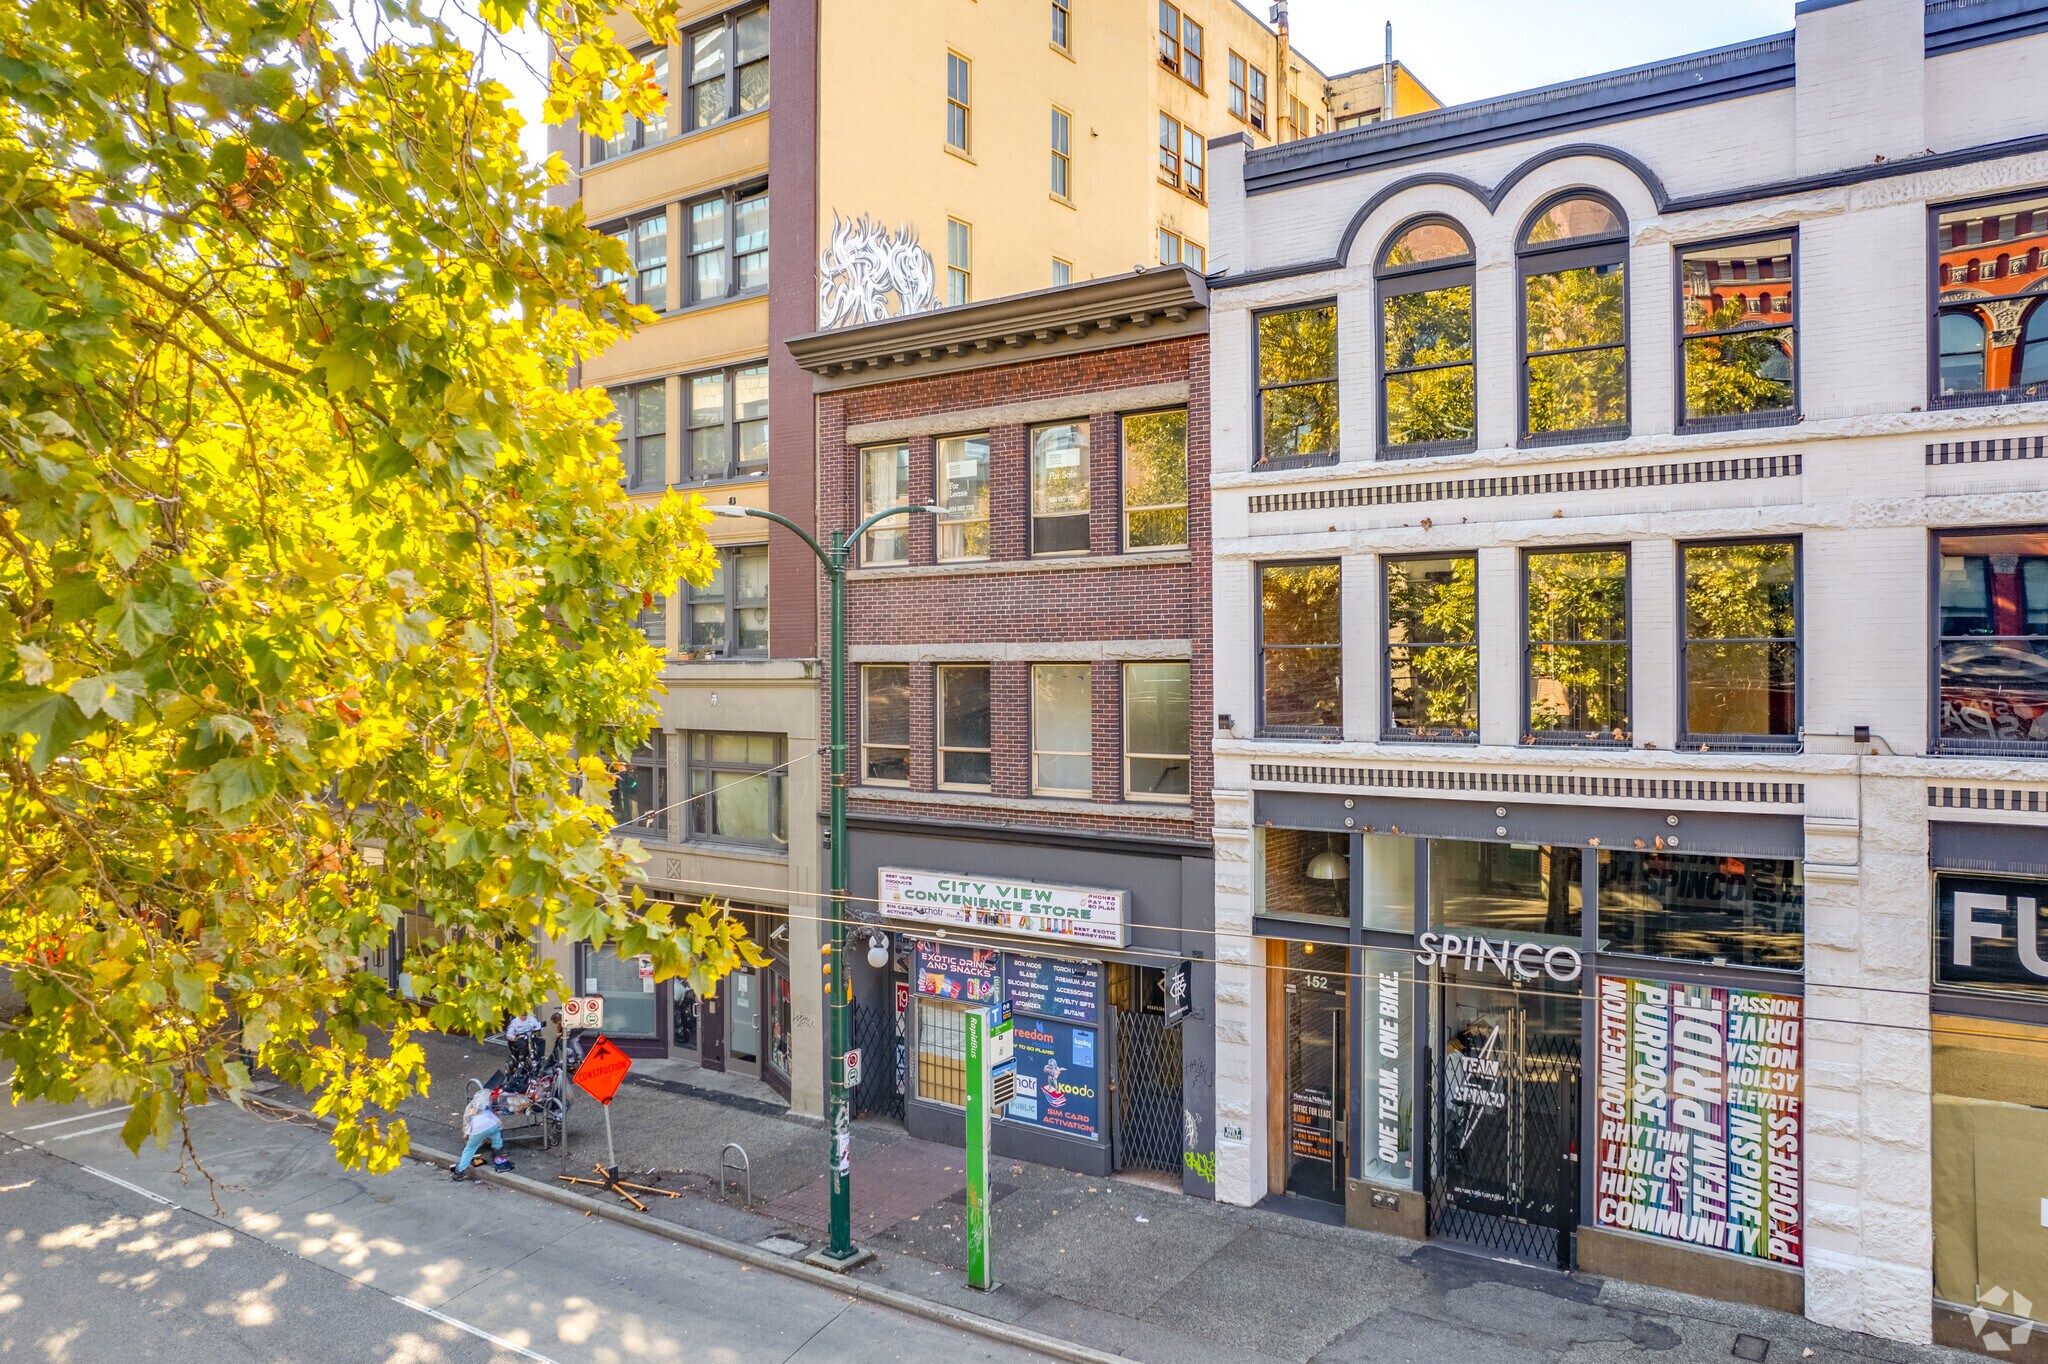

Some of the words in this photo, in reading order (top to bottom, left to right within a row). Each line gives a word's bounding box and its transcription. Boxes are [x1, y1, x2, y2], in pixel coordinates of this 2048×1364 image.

[1062, 470, 1078, 478] Sale
[938, 880, 985, 894] CITY
[996, 886, 1052, 902] VIEW
[1643, 867, 1746, 902] SPINCO
[905, 890, 1022, 911] CONVENIENCE
[1030, 904, 1091, 919] STORE
[1953, 891, 2048, 977] FU
[922, 953, 956, 964] EXOTIC
[1417, 932, 1582, 981] SPINCO
[927, 962, 947, 970] AND
[950, 965, 991, 977] SNACKS
[1019, 971, 1036, 979] GLASS
[1055, 976, 1080, 985] PREMIUM
[1071, 968, 1097, 977] LERS
[1008, 979, 1029, 987] SILICONE
[1031, 982, 1048, 991] BONGS
[1056, 987, 1093, 998] ACCESSORIES
[1305, 975, 1328, 989] 152
[1015, 1001, 1041, 1009] ATOMIZER
[1054, 997, 1078, 1005] NOVELTY
[1080, 1001, 1095, 1009] GIFTS
[1379, 971, 1398, 1018] BIKE.
[992, 1008, 999, 1023] T
[1064, 1009, 1085, 1017] BUTANE
[1729, 995, 1799, 1017] PASSION
[970, 1017, 978, 1059] RapidBus
[1014, 1028, 1053, 1043] reedom
[1379, 1019, 1398, 1059] ONE
[1730, 1016, 1799, 1046] DRIVE
[1031, 1041, 1053, 1049] mobile
[1074, 1038, 1092, 1048] lucky
[1602, 979, 1627, 1120] CONNECTION
[1634, 983, 1668, 1127] PURPOSE
[1673, 989, 1722, 1136] PRIDE
[1726, 1042, 1798, 1069] VISION
[578, 1060, 627, 1081] CONSTRUCTION
[1462, 1057, 1499, 1077] TEAM
[1727, 1066, 1799, 1092] ACTION
[1379, 1067, 1398, 1122] TEAM.
[1454, 1086, 1505, 1108] SPINCO
[1727, 1088, 1798, 1113] ELEVATE
[1011, 1101, 1035, 1112] PUBLIC
[1047, 1109, 1063, 1117] SIM
[1065, 1113, 1089, 1122] CARD
[1293, 1104, 1308, 1114] OFFICE
[1309, 1107, 1317, 1116] FOR
[1319, 1109, 1331, 1119] LEASE
[1043, 1116, 1094, 1132] ACTIVATION!
[1379, 1123, 1398, 1164] ONE
[1601, 1120, 1690, 1153] RHYTHM
[1602, 1145, 1689, 1181] SPIRIT
[1731, 1108, 1762, 1225] INSPIRE
[1693, 1134, 1727, 1217] TEAM
[1601, 1172, 1689, 1207] HUSTLE
[1768, 1113, 1799, 1262] PROGRESS
[1600, 1198, 1760, 1253] COMMUNITY
